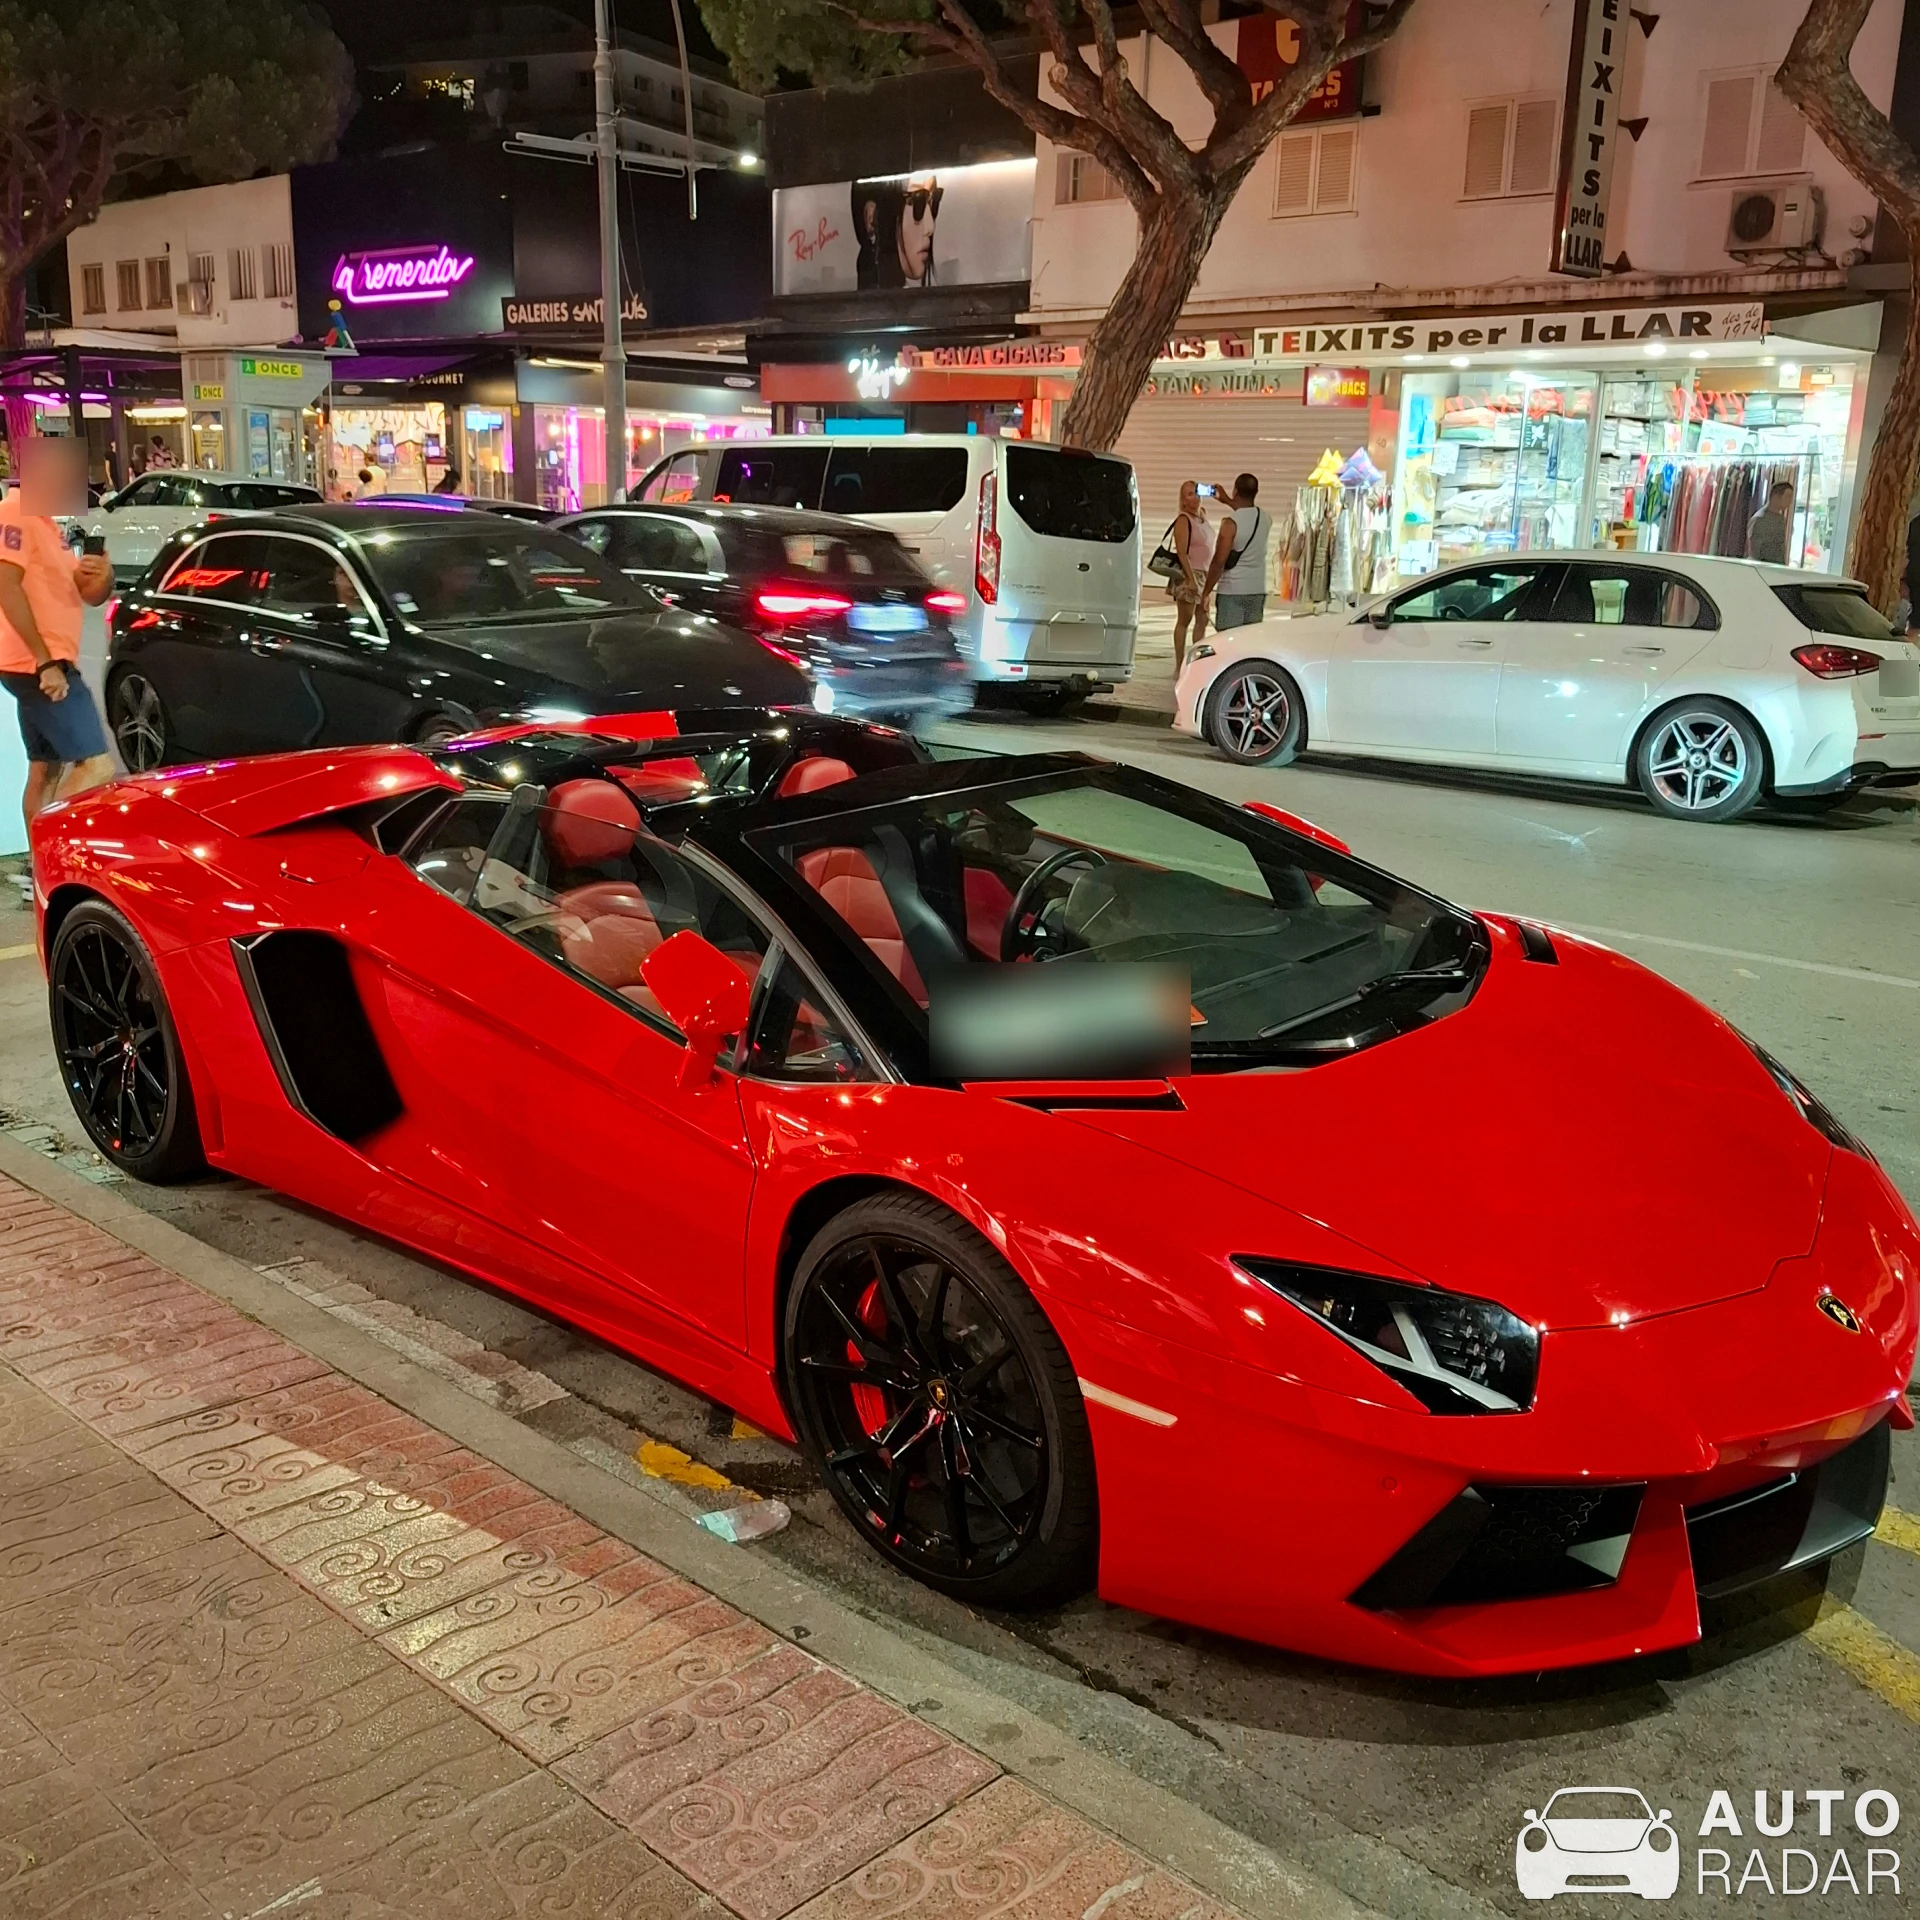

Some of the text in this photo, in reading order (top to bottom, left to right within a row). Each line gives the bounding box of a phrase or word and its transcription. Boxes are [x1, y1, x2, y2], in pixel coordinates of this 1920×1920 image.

[1571, 203, 1605, 228] per la
[1566, 233, 1603, 270] LLAR
[507, 302, 569, 324] GALERIES
[1258, 311, 1713, 354] TEIXITS per la LLAR
[1724, 317, 1760, 340] 1974
[933, 346, 986, 367] CAVA
[990, 343, 1066, 365] CIGARS
[260, 362, 299, 376] ONCE
[202, 387, 222, 398] ONCE
[1333, 381, 1366, 396] ABACS
